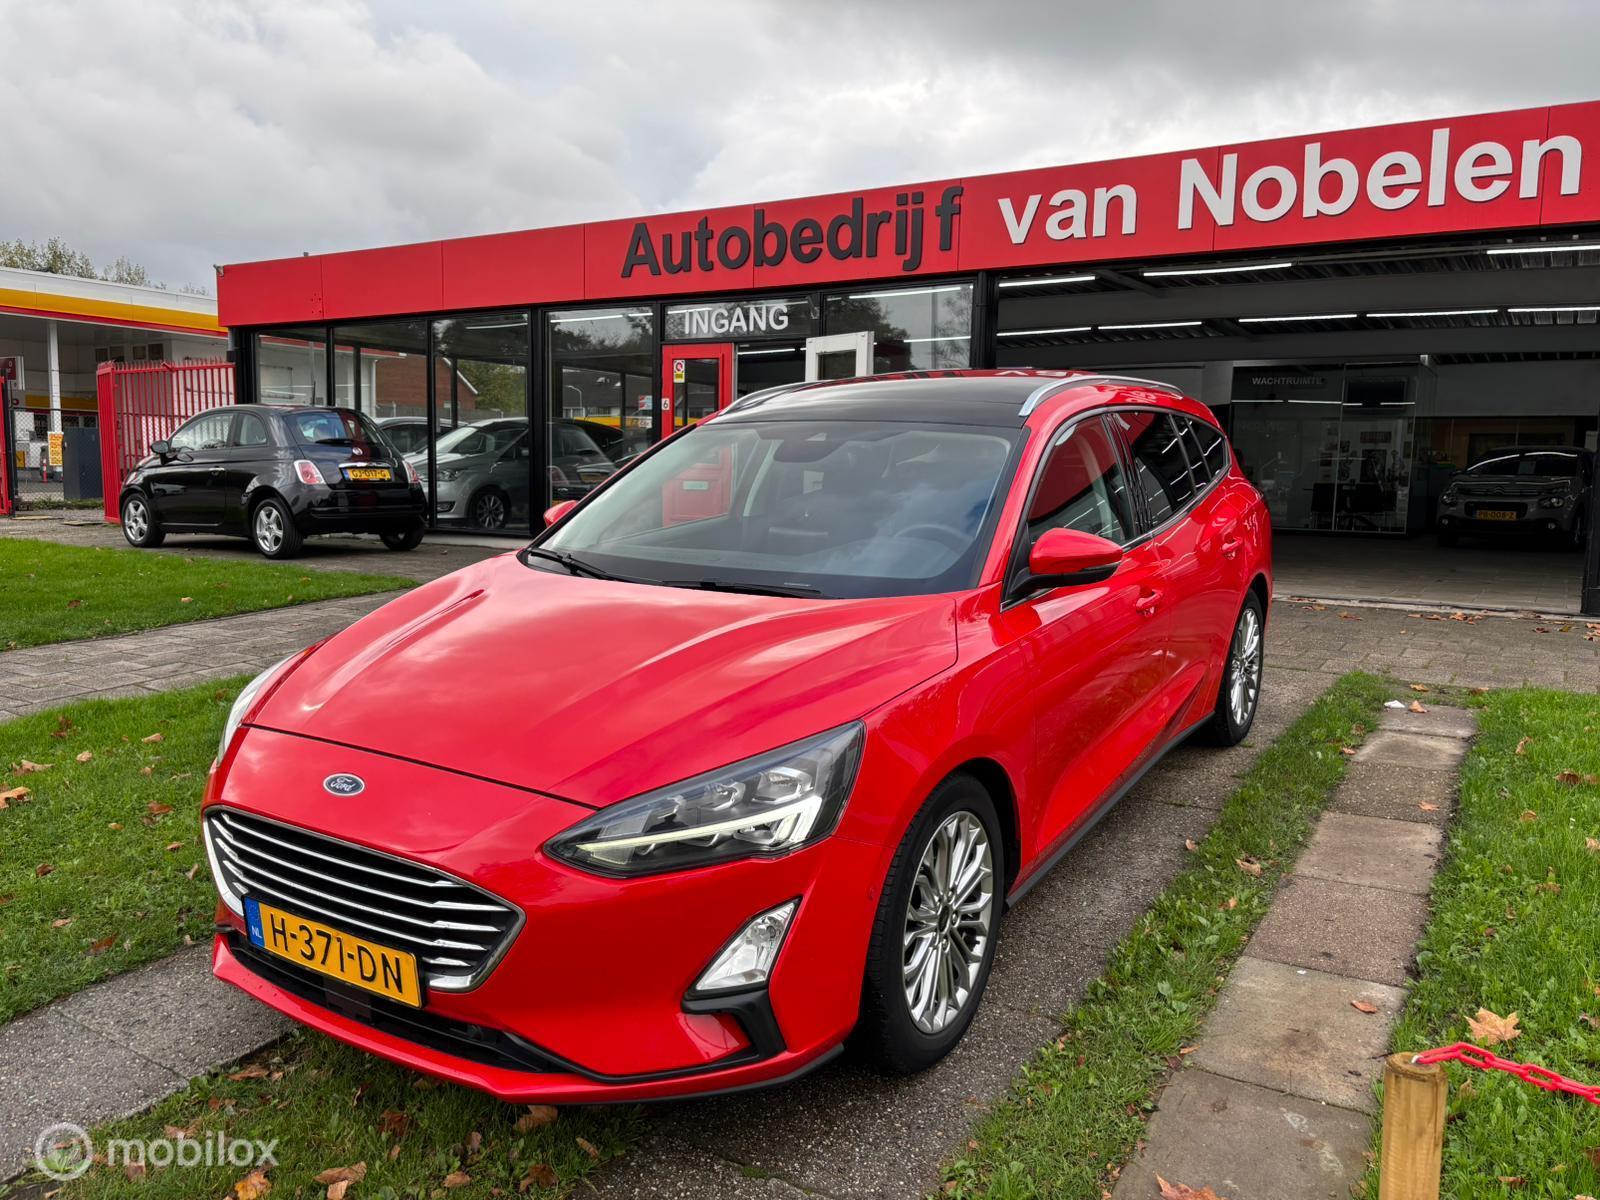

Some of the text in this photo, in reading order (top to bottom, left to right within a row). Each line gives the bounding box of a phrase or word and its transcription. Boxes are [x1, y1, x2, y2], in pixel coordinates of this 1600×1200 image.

[621, 127, 1583, 278] Autobedrijf van Nobelen
[684, 305, 789, 335] INGANG
[663, 399, 669, 408] 6
[330, 776, 356, 791] Ford
[251, 925, 263, 939] NL
[270, 913, 403, 994] H-371-DN
